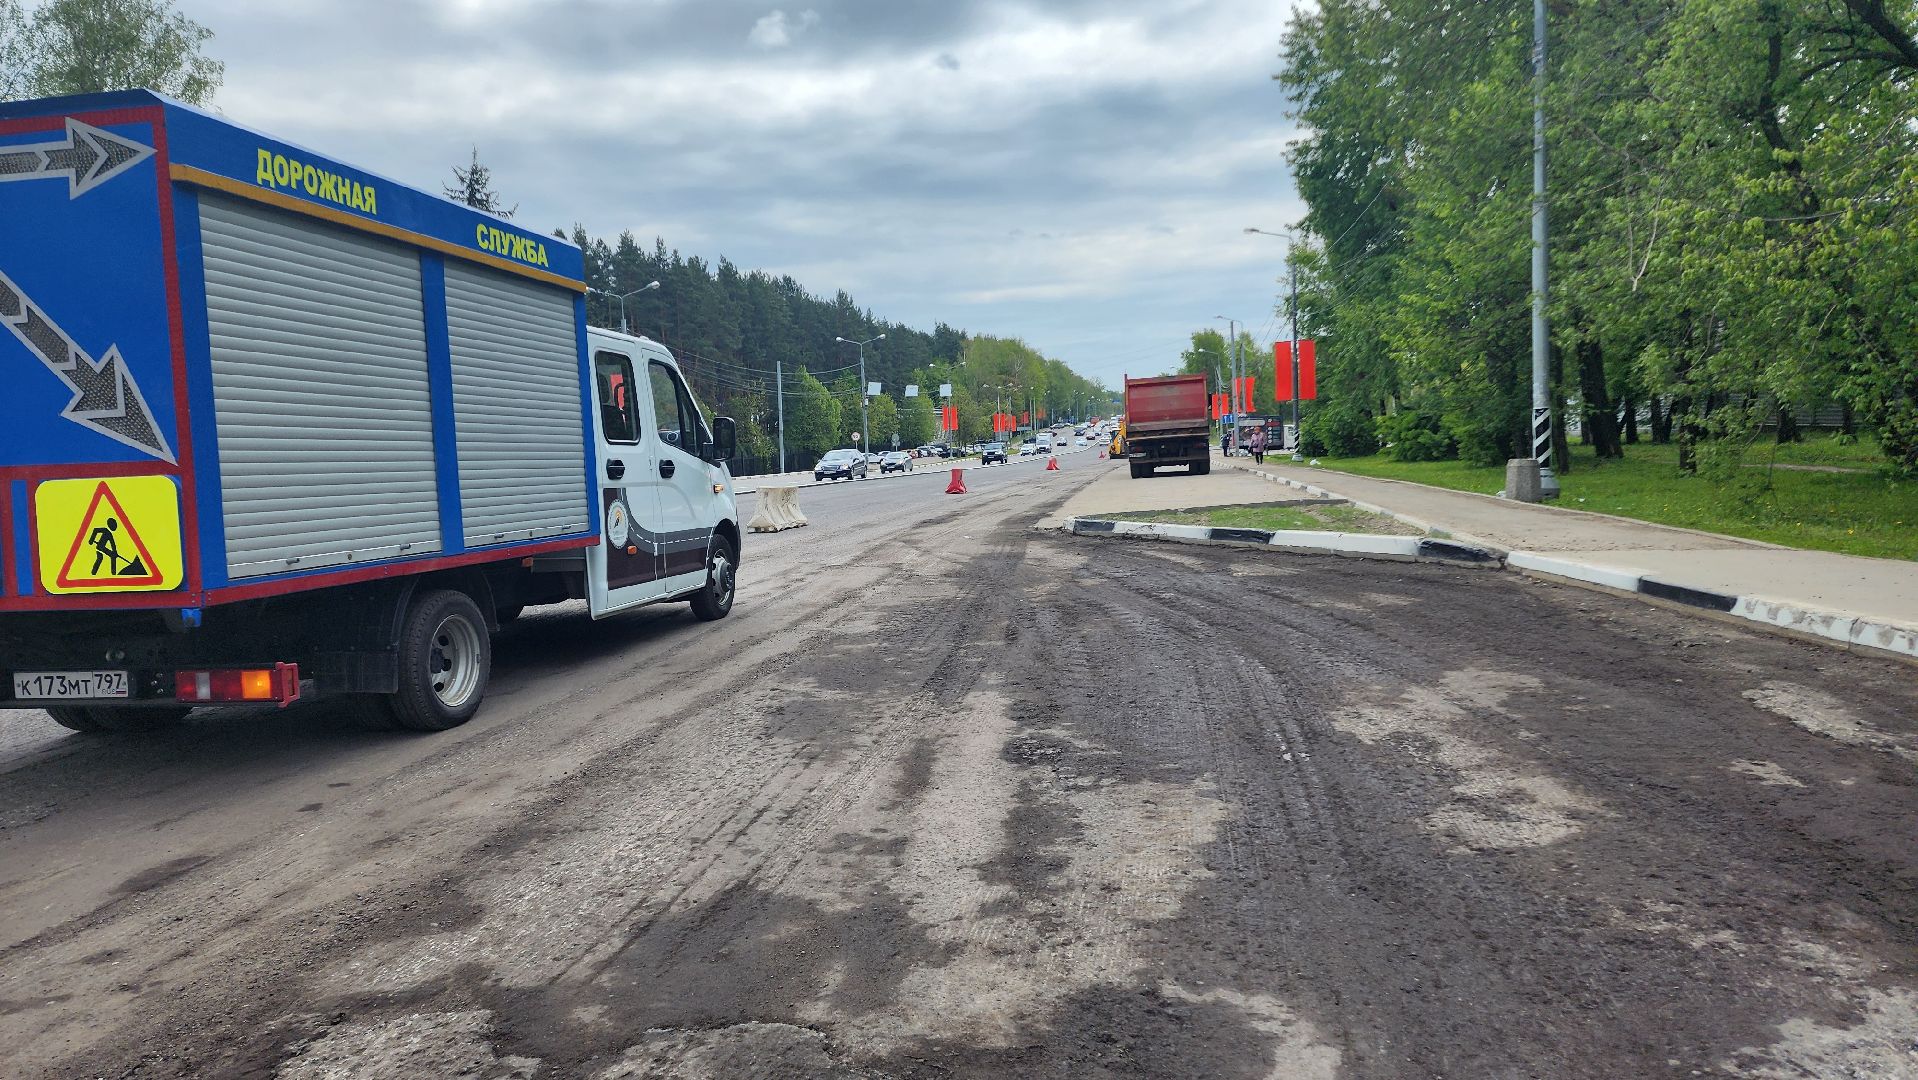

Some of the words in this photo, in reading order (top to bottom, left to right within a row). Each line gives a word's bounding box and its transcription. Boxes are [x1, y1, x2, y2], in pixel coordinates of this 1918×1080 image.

[256, 148, 377, 215] ДОРОЖНАЯ
[476, 223, 549, 268] СЛУЖБА
[21, 675, 91, 696] К173МТ
[94, 673, 122, 690] 797
